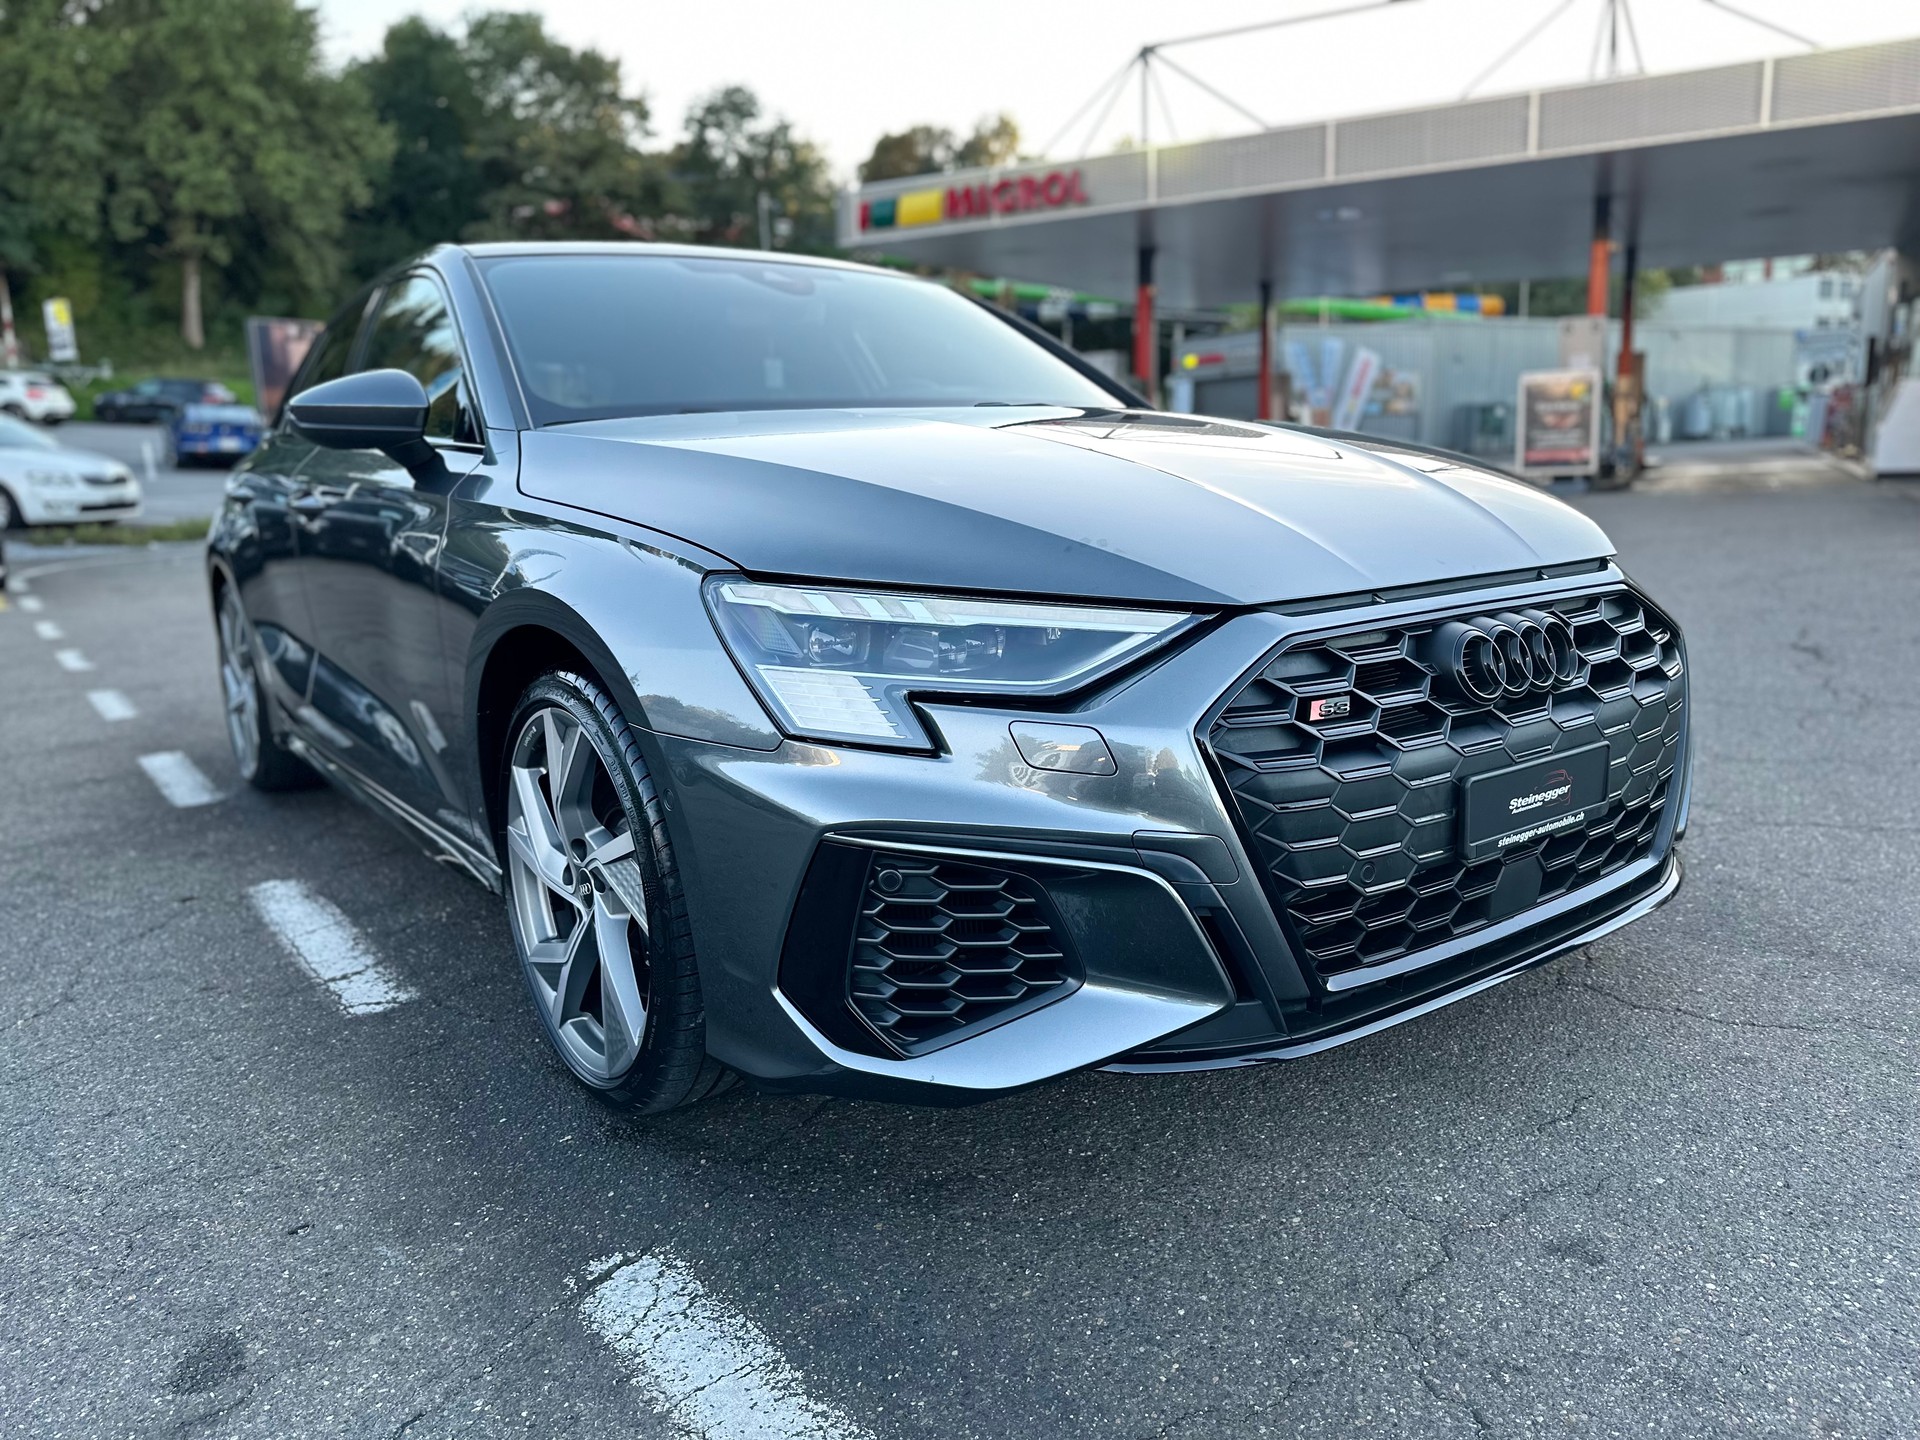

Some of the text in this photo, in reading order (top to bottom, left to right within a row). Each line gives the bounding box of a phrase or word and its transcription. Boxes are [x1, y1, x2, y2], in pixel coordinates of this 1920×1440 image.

[945, 169, 1088, 219] MIGROL
[1320, 702, 1350, 715] S3
[1509, 784, 1571, 810] Steinegger
[1498, 811, 1585, 847] steinegger-automobile.ch
